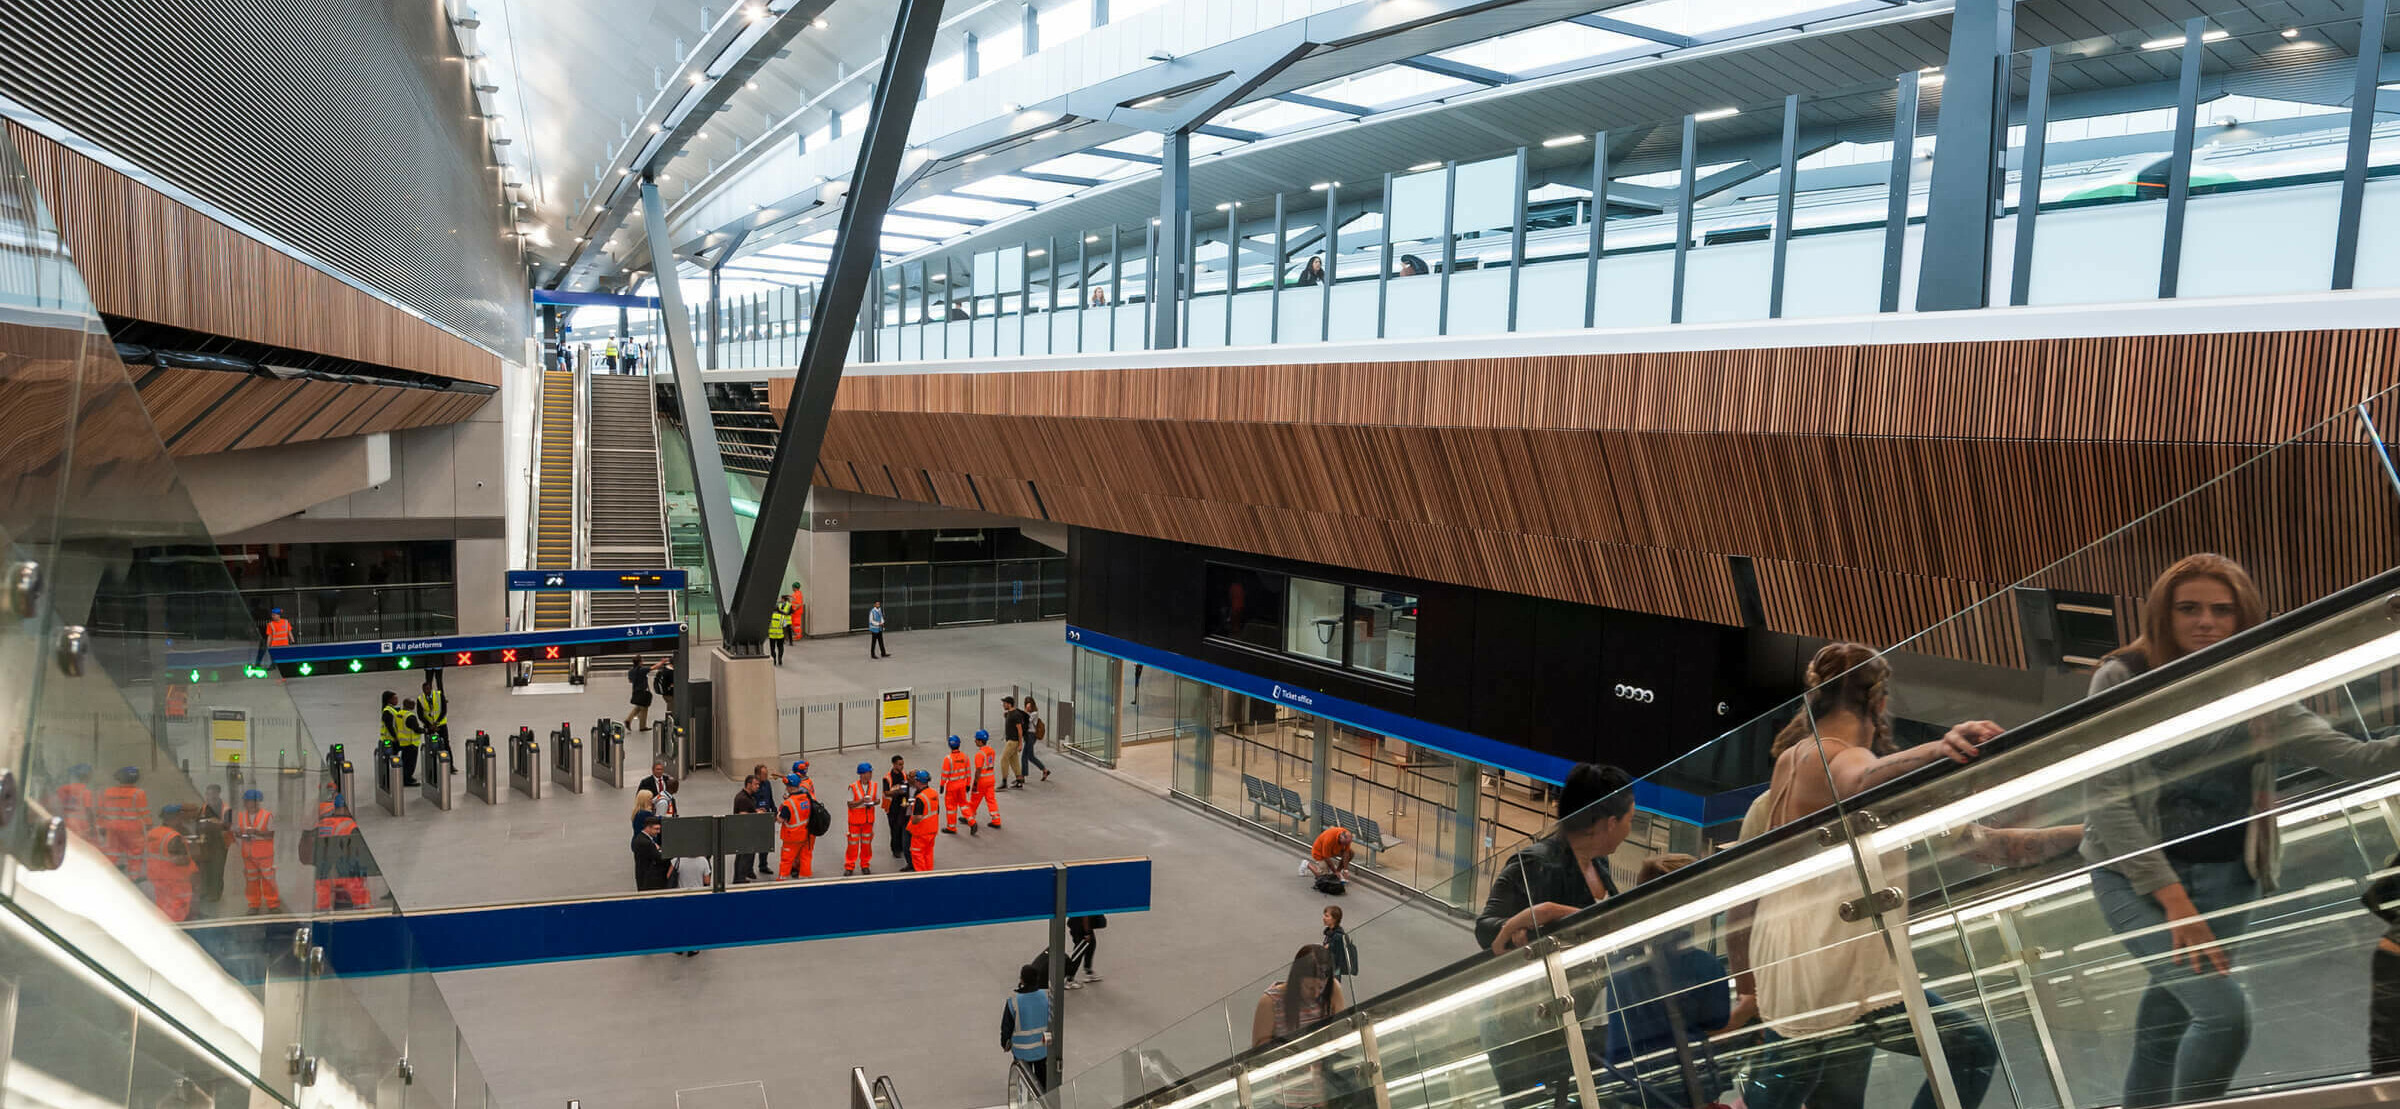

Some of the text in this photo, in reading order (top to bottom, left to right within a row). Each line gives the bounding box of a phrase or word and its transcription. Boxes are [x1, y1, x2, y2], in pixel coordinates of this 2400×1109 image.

[408, 641, 442, 650] platforms
[1282, 689, 1312, 705] Ticket office
